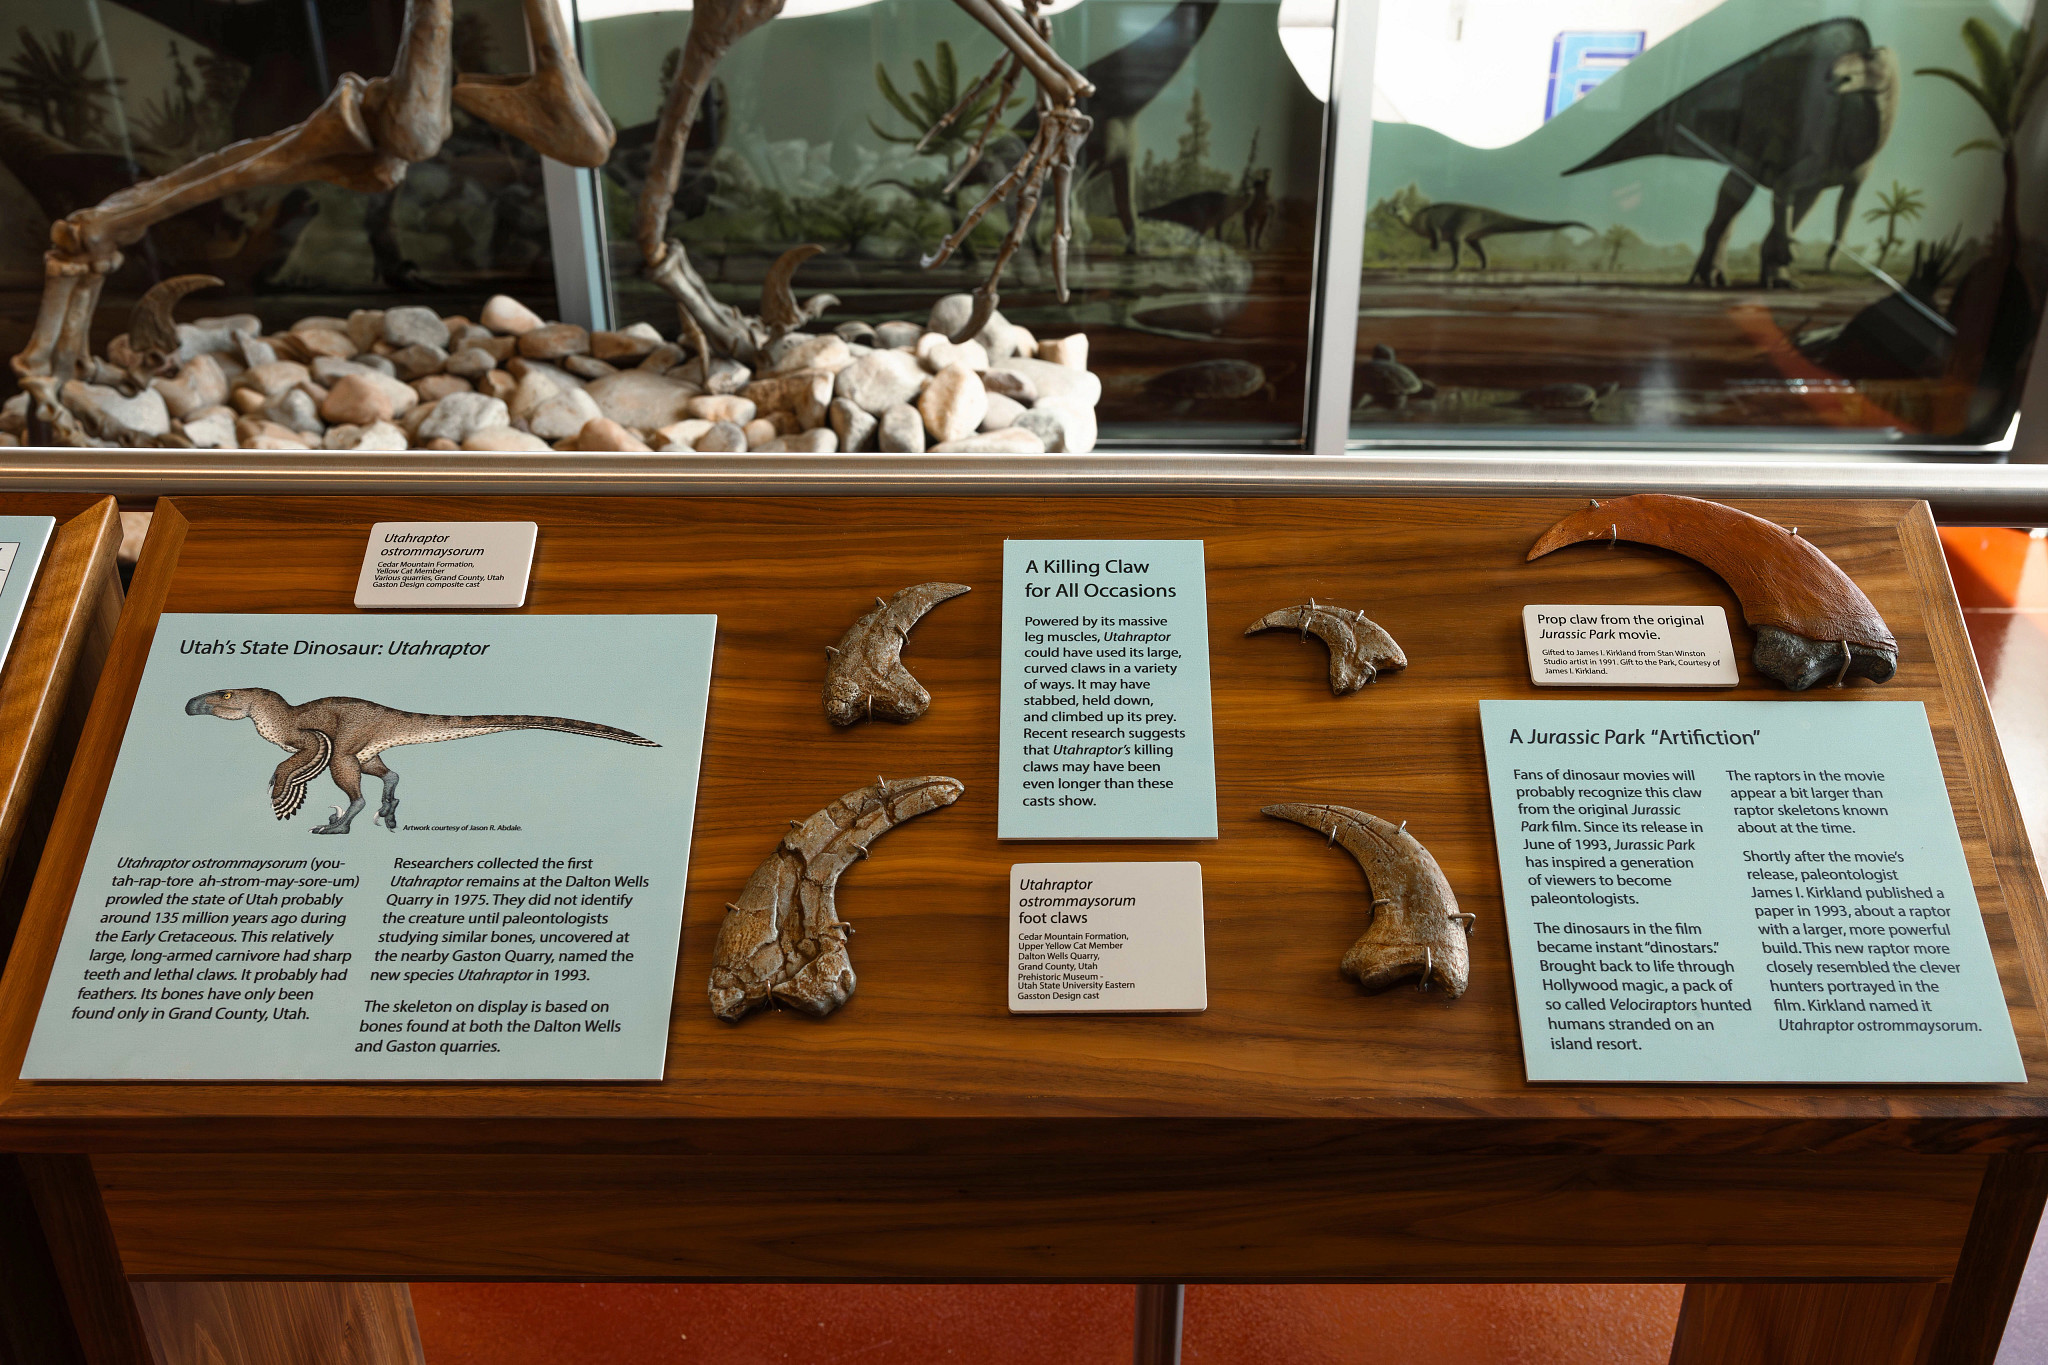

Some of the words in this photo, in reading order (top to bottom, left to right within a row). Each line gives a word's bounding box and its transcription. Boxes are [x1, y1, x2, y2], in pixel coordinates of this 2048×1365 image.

[384, 533, 450, 545] Utahraptor
[380, 547, 484, 558] ostrommaysorum
[1025, 560, 1039, 573] A
[1044, 559, 1100, 577] Killing
[1105, 559, 1149, 573] Claw
[458, 574, 485, 582] County,
[399, 581, 425, 589] Design
[1025, 583, 1051, 598] for
[1055, 583, 1078, 597] All
[1084, 583, 1176, 598] Occasions
[1025, 616, 1079, 626] Powered
[1083, 616, 1098, 629] by
[1101, 616, 1115, 626] its
[1118, 616, 1168, 626] massive
[1537, 614, 1567, 627] Prop
[1570, 614, 1598, 624] claw
[1600, 614, 1631, 625] from
[1633, 614, 1654, 625] the
[1657, 615, 1704, 628] original
[1025, 631, 1044, 645] leg
[1047, 631, 1100, 643] muscles,
[1104, 631, 1171, 644] Utahraptor
[1539, 629, 1586, 639] Jurassic
[1589, 629, 1616, 639] Park
[1619, 630, 1660, 640] movie.
[180, 639, 236, 655] Utah’s
[240, 640, 289, 655] State
[293, 640, 383, 655] Dinosaur:
[388, 640, 490, 659] Utahraptor
[1024, 647, 1059, 658] could
[1063, 647, 1093, 658] have
[1096, 647, 1126, 657] used
[1130, 647, 1144, 657] its
[1147, 647, 1182, 660] large,
[1678, 659, 1711, 668] Courtesy
[1509, 729, 1524, 744] A
[1527, 729, 1600, 744] Jurassic
[1605, 729, 1645, 745] Park
[1651, 729, 1760, 745] “Artifiction”
[1513, 769, 1543, 780] Fans
[1546, 769, 1560, 780] of
[1562, 769, 1620, 781] dinosaur
[1623, 770, 1670, 781] movies
[1672, 770, 1695, 781] will
[1725, 770, 1751, 781] The
[1754, 771, 1801, 784] raptors
[1803, 770, 1816, 781] in
[1819, 770, 1841, 781] the
[1844, 770, 1885, 781] movie
[1516, 786, 1575, 800] probably
[1578, 787, 1642, 800] recognize
[1645, 786, 1670, 798] this
[1672, 787, 1702, 798] claw
[1734, 805, 1774, 818] raptor
[1778, 804, 1840, 816] skeletons
[1842, 804, 1888, 816] known
[117, 856, 191, 871] Utahraptor
[192, 858, 308, 872] ostrommaysorum
[311, 857, 345, 872] (you-
[394, 857, 474, 869] Researchers
[477, 857, 539, 869] collected
[542, 857, 564, 869] the
[567, 857, 594, 869] first
[112, 874, 194, 889] tah-rap-tore
[198, 875, 359, 890] ah-strom-may-sore-um)
[390, 875, 464, 890] Utahraptor
[466, 876, 520, 887] remains
[523, 877, 537, 887] at
[540, 875, 562, 887] the
[565, 875, 611, 887] Dalton
[614, 875, 649, 887] Wells
[1020, 878, 1093, 893] Utahraptor
[105, 893, 164, 908] prowled
[166, 893, 189, 905] the
[191, 894, 225, 905] state
[228, 893, 245, 905] of
[246, 893, 278, 905] Utah
[281, 893, 344, 908] probably
[1019, 896, 1136, 910] ostrommaysorum
[100, 911, 151, 923] around
[156, 912, 180, 924] 135
[182, 911, 229, 924] million
[231, 915, 268, 927] years
[270, 915, 298, 927] ago
[300, 911, 346, 927] during
[1019, 911, 1047, 924] foot
[1050, 911, 1088, 924] claws
[1018, 933, 1043, 941] Cedar
[1085, 932, 1129, 940] Formation,
[1018, 942, 1044, 952] Upper
[1045, 942, 1072, 950] Yellow
[1088, 941, 1123, 949] Member
[1018, 952, 1046, 960] Dalton
[1047, 952, 1069, 960] Wells
[1070, 952, 1100, 961] Quarry,
[1018, 962, 1043, 971] Grand
[1045, 962, 1076, 972] County,
[1078, 962, 1098, 970] Utah
[1018, 973, 1061, 981] Prehistoric
[1063, 973, 1098, 981] Museum
[1018, 981, 1038, 990] Utah
[1039, 981, 1061, 989] State
[1062, 981, 1103, 991] University
[1105, 981, 1135, 989] Eastern
[1017, 992, 1051, 1000] Gasston
[1052, 992, 1081, 1001] Design
